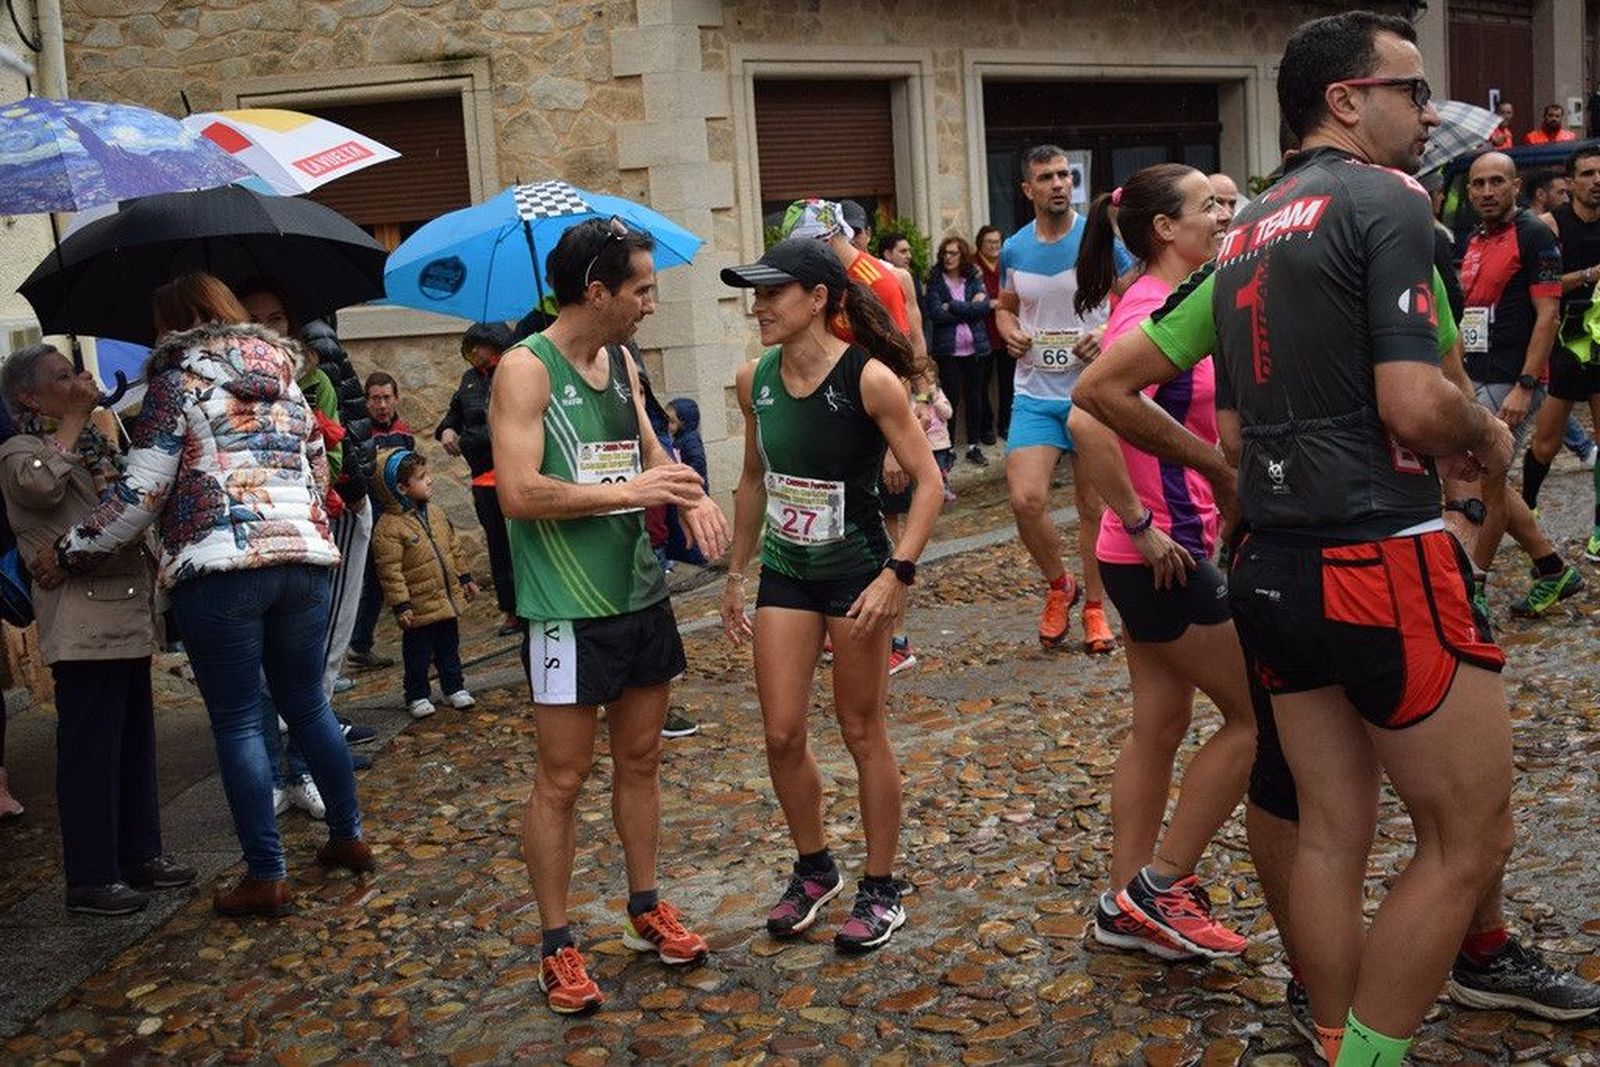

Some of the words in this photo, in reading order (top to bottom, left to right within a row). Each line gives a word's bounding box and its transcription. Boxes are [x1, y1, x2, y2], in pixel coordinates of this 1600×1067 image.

[302, 158, 326, 173] LA
[319, 145, 367, 169] VUELTA
[1255, 199, 1325, 246] TEAM
[1043, 350, 1069, 365] 66
[783, 507, 818, 536] 27
